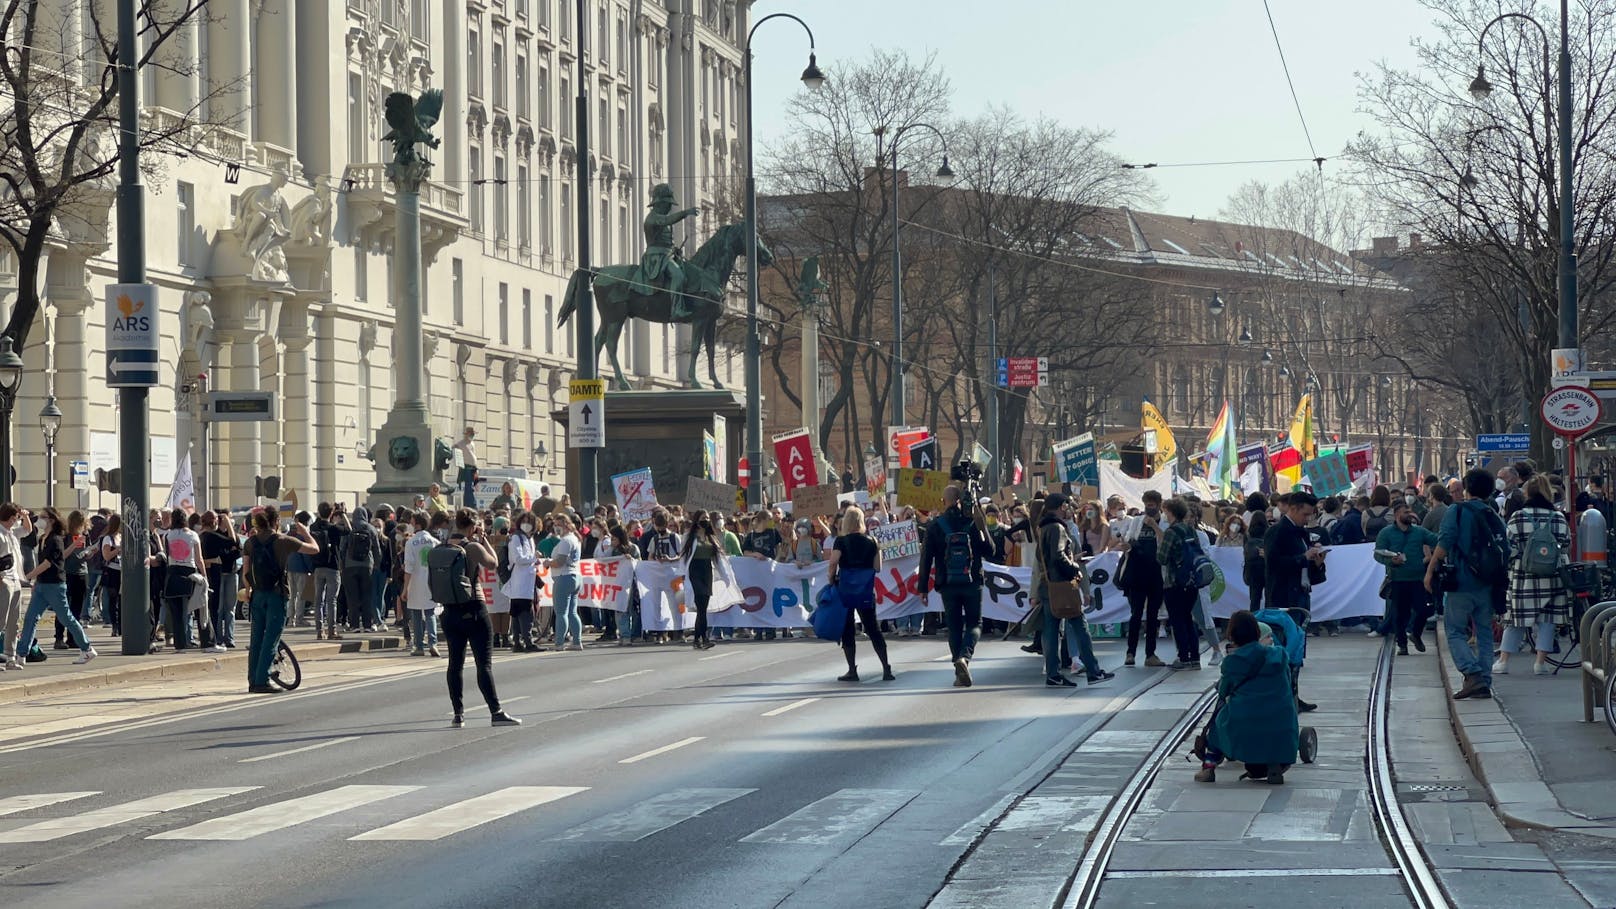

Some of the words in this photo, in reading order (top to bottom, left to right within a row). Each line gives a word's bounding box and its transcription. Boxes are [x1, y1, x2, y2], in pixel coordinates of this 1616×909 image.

[227, 166, 239, 182] W
[113, 316, 150, 331] ARS
[1548, 391, 1595, 408] STRASSENBAHN
[1549, 414, 1592, 428] HALTESTELLE
